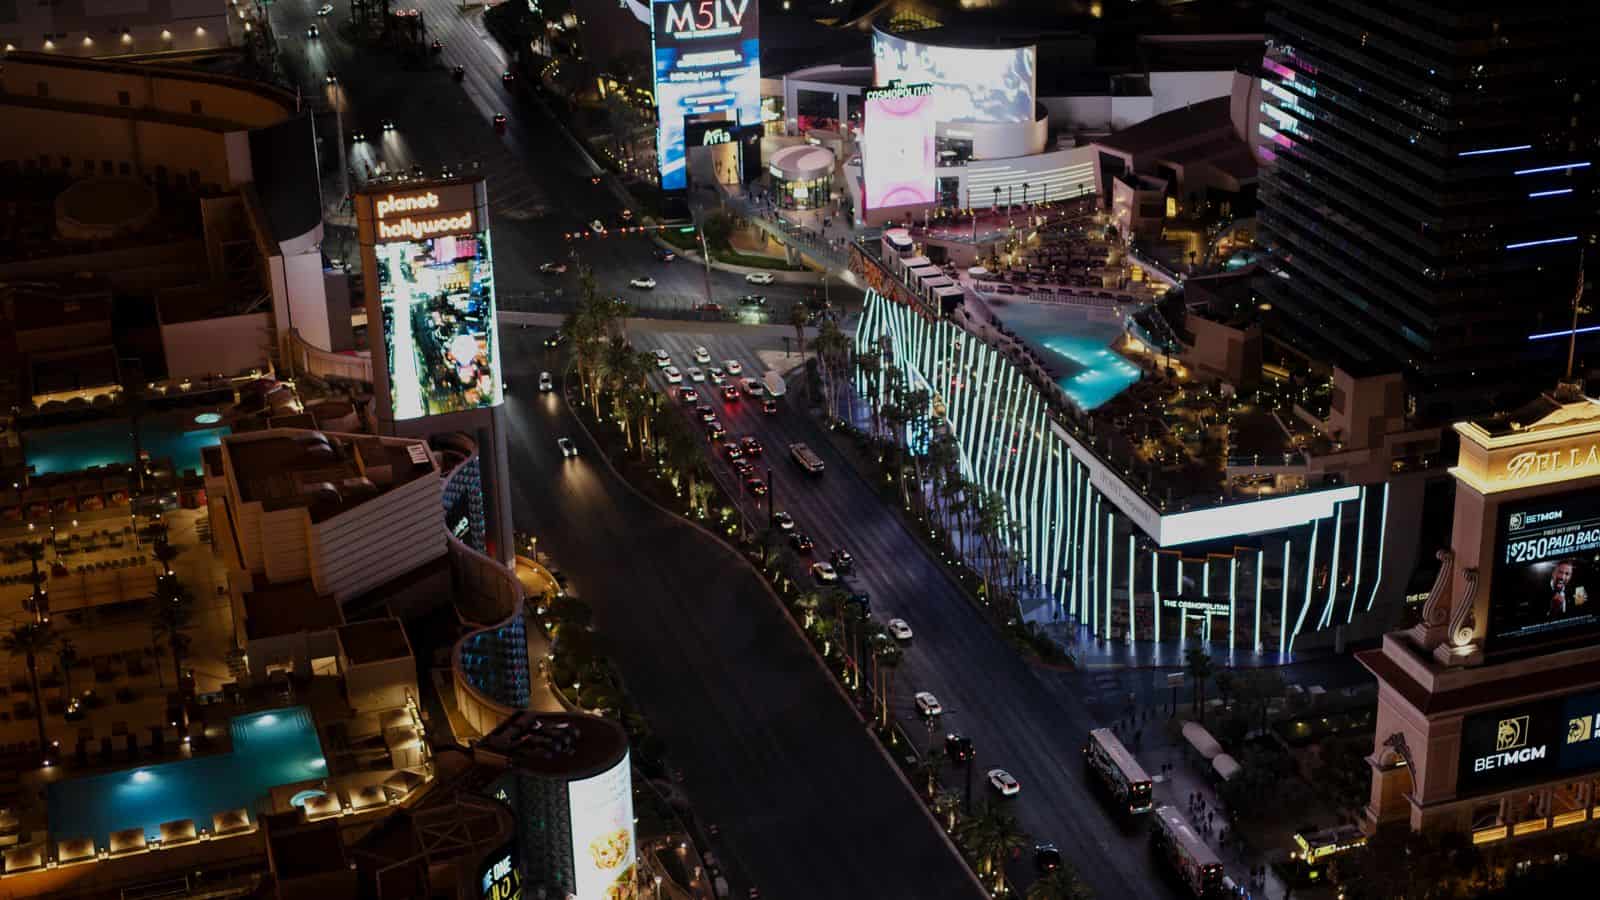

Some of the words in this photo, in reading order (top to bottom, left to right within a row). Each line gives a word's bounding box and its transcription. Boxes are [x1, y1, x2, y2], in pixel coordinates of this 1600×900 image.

[664, 0, 749, 33] M5LV
[866, 88, 936, 101] COSMOPOLITAN
[376, 192, 439, 218] planet
[379, 211, 472, 238] hollywood
[1526, 510, 1563, 524] BETMGM
[1511, 537, 1548, 562] $250
[1548, 533, 1574, 549] PAID
[1576, 528, 1600, 545] BAC
[1163, 600, 1177, 608] THE
[1178, 601, 1230, 611] COSMOPOLITAN
[1474, 745, 1546, 772] BETMGM
